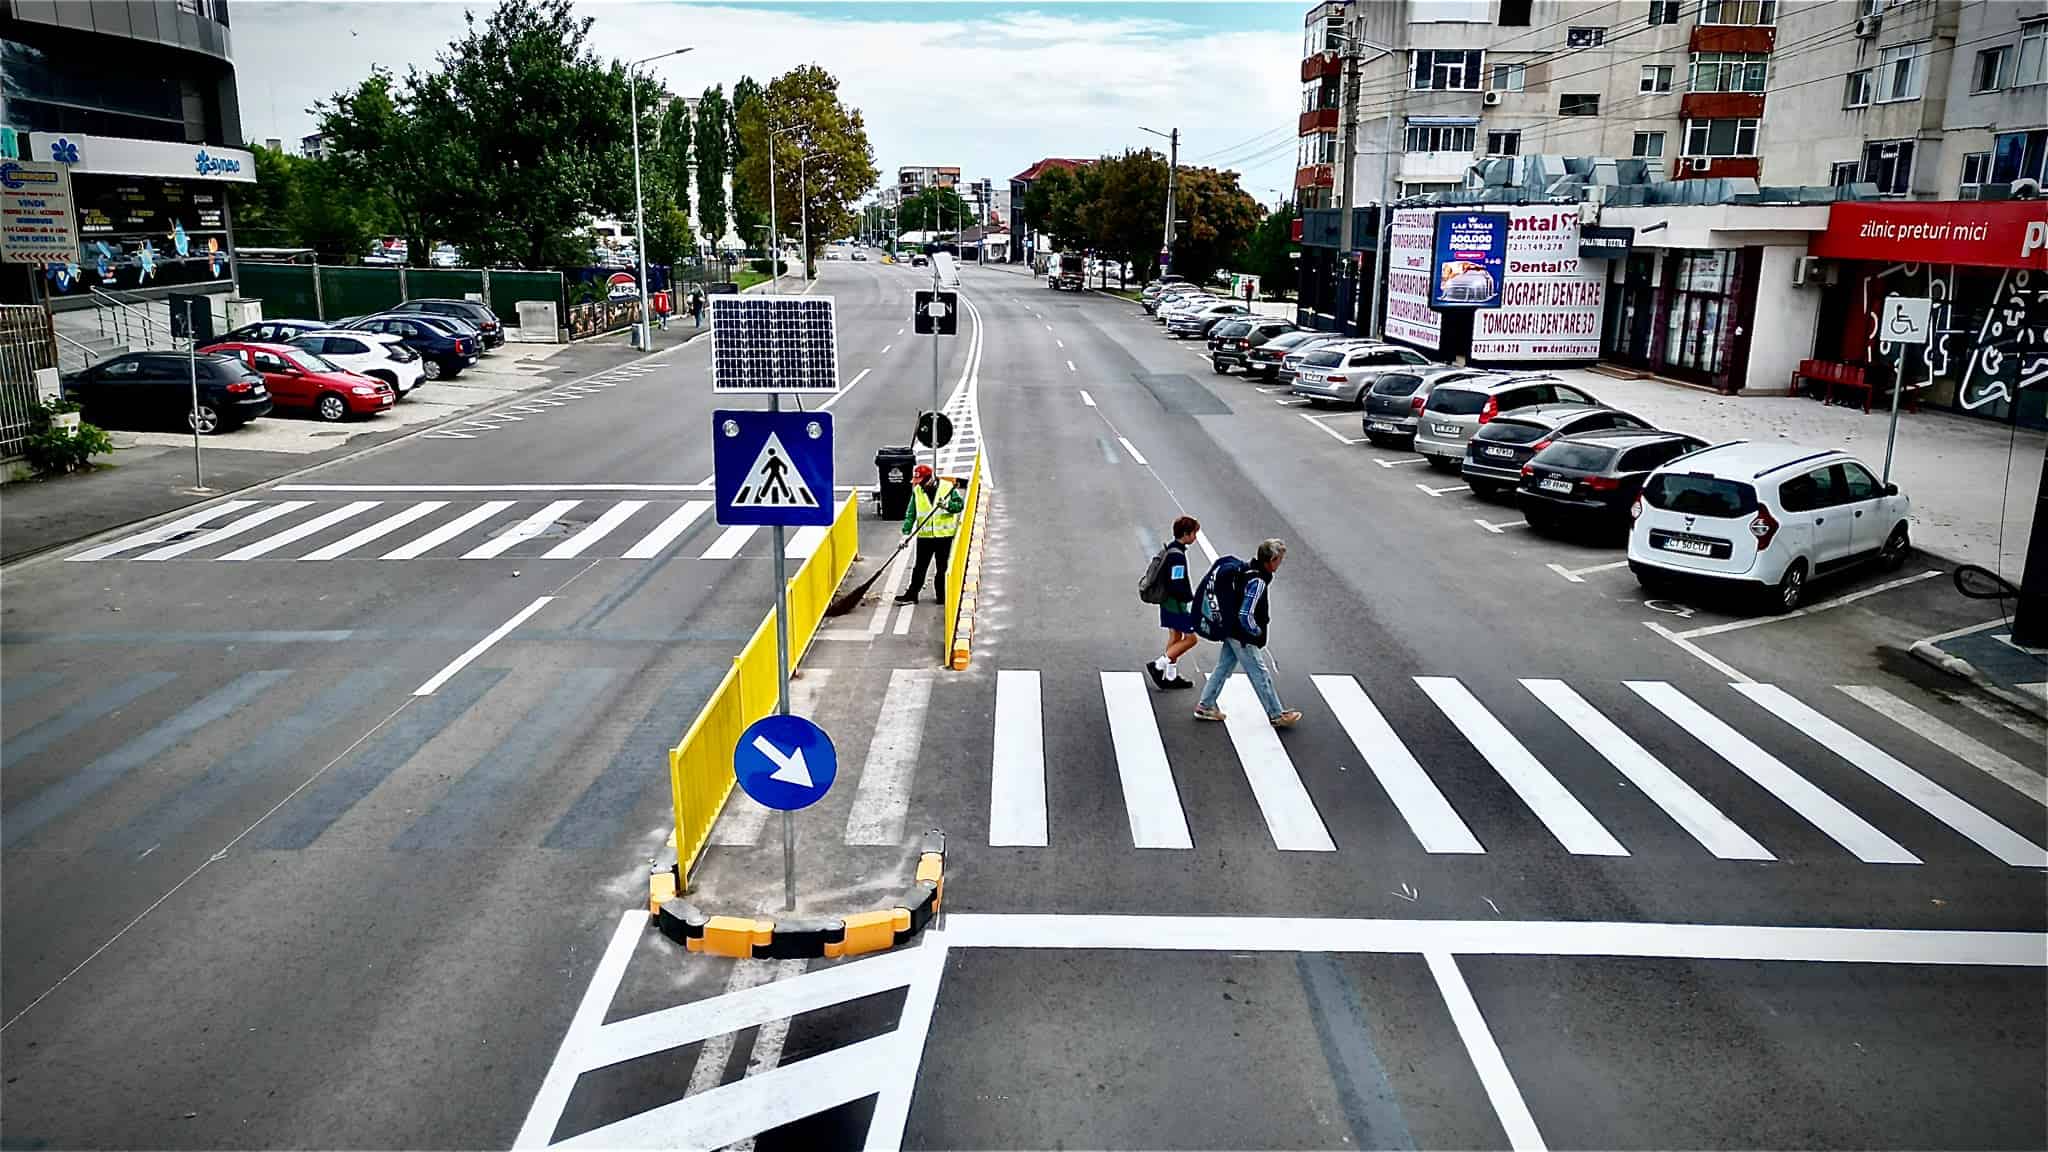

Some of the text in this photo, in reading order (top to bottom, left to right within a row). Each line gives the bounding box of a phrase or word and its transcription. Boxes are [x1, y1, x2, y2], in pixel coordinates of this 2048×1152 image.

[1451, 222, 1494, 230] LAS VEGAS
[1860, 219, 1988, 242] zilnic preturi mici
[1450, 233, 1493, 243] 500.000
[1551, 282, 1600, 306] DENTARE
[1483, 313, 1595, 334] TOMOGRAFII DENTARE 3D
